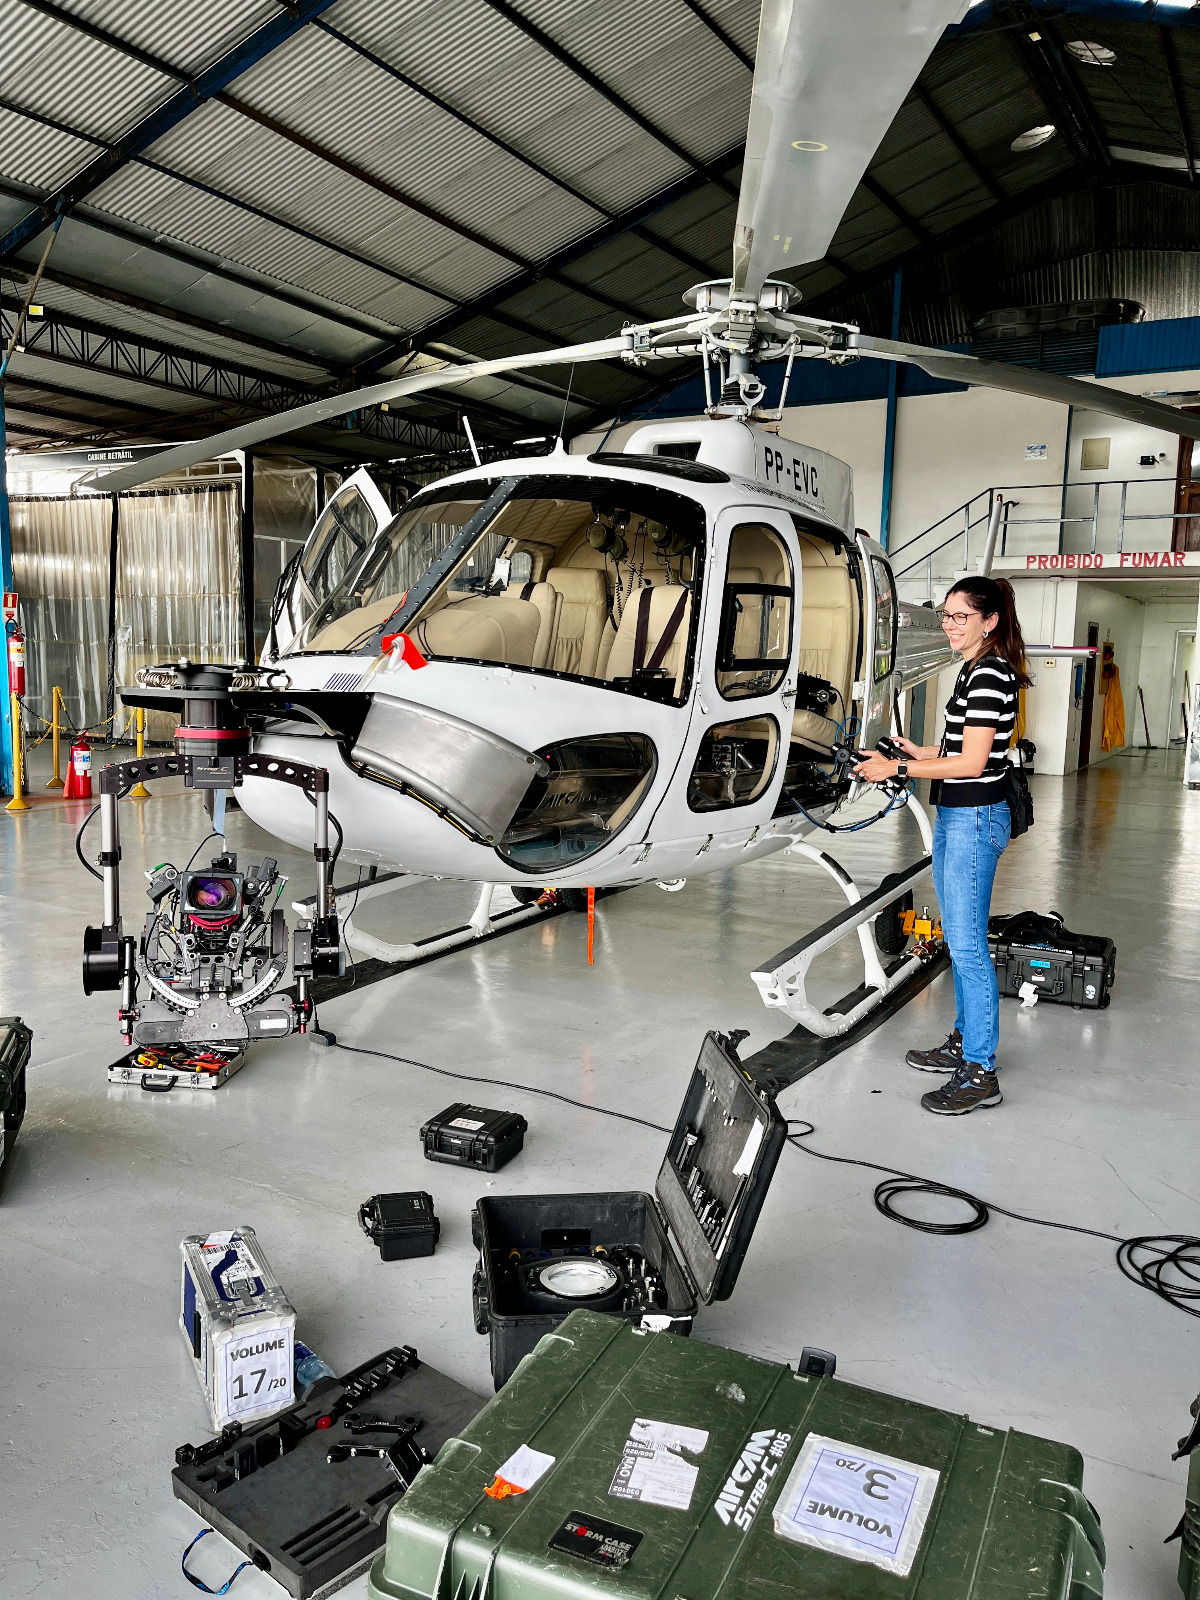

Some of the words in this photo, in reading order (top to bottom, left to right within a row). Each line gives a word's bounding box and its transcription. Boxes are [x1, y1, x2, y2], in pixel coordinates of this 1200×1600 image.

[87, 453, 107, 462] CABINE
[108, 450, 133, 460] RETRÁTIL
[764, 446, 819, 498] PP-EVC
[1026, 553, 1104, 569] PROIBIDO
[1119, 551, 1187, 568] FUMAR
[230, 1338, 286, 1362] VOLUME
[769, 1431, 792, 1457] #05
[805, 1499, 893, 1538] VOLUME
[564, 1522, 604, 1542] STORM
[604, 1537, 632, 1551] CASE
